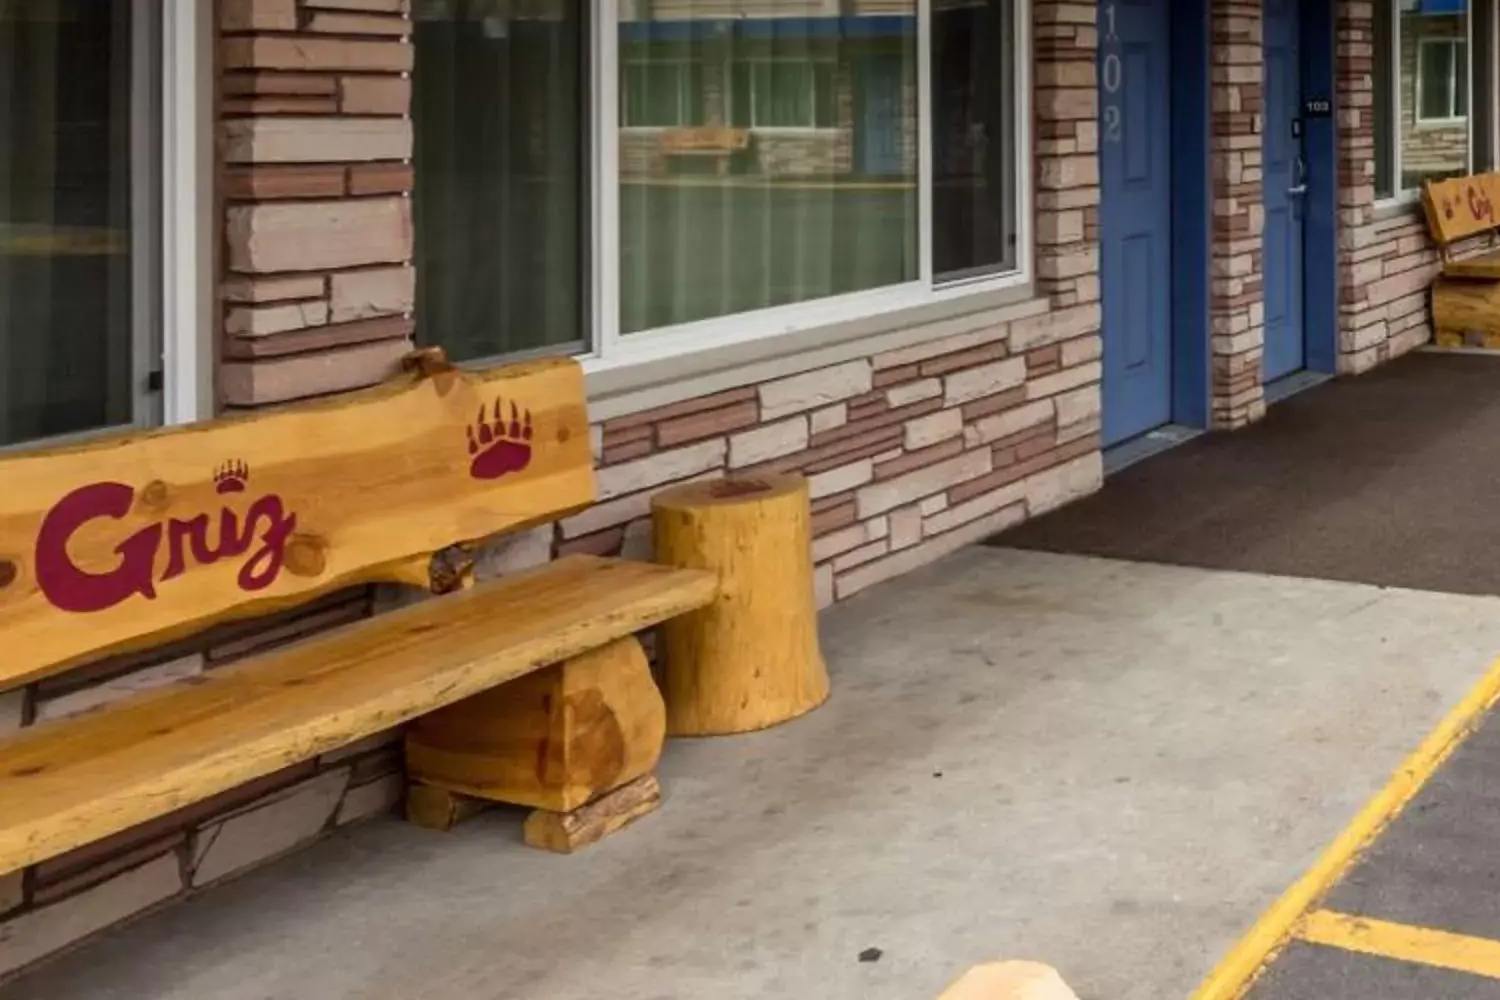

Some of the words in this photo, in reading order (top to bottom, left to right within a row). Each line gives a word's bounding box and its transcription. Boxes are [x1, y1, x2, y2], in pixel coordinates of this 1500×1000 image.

[1103, 4, 1121, 143] 102
[1306, 101, 1329, 112] 103
[35, 462, 296, 614] Griz
